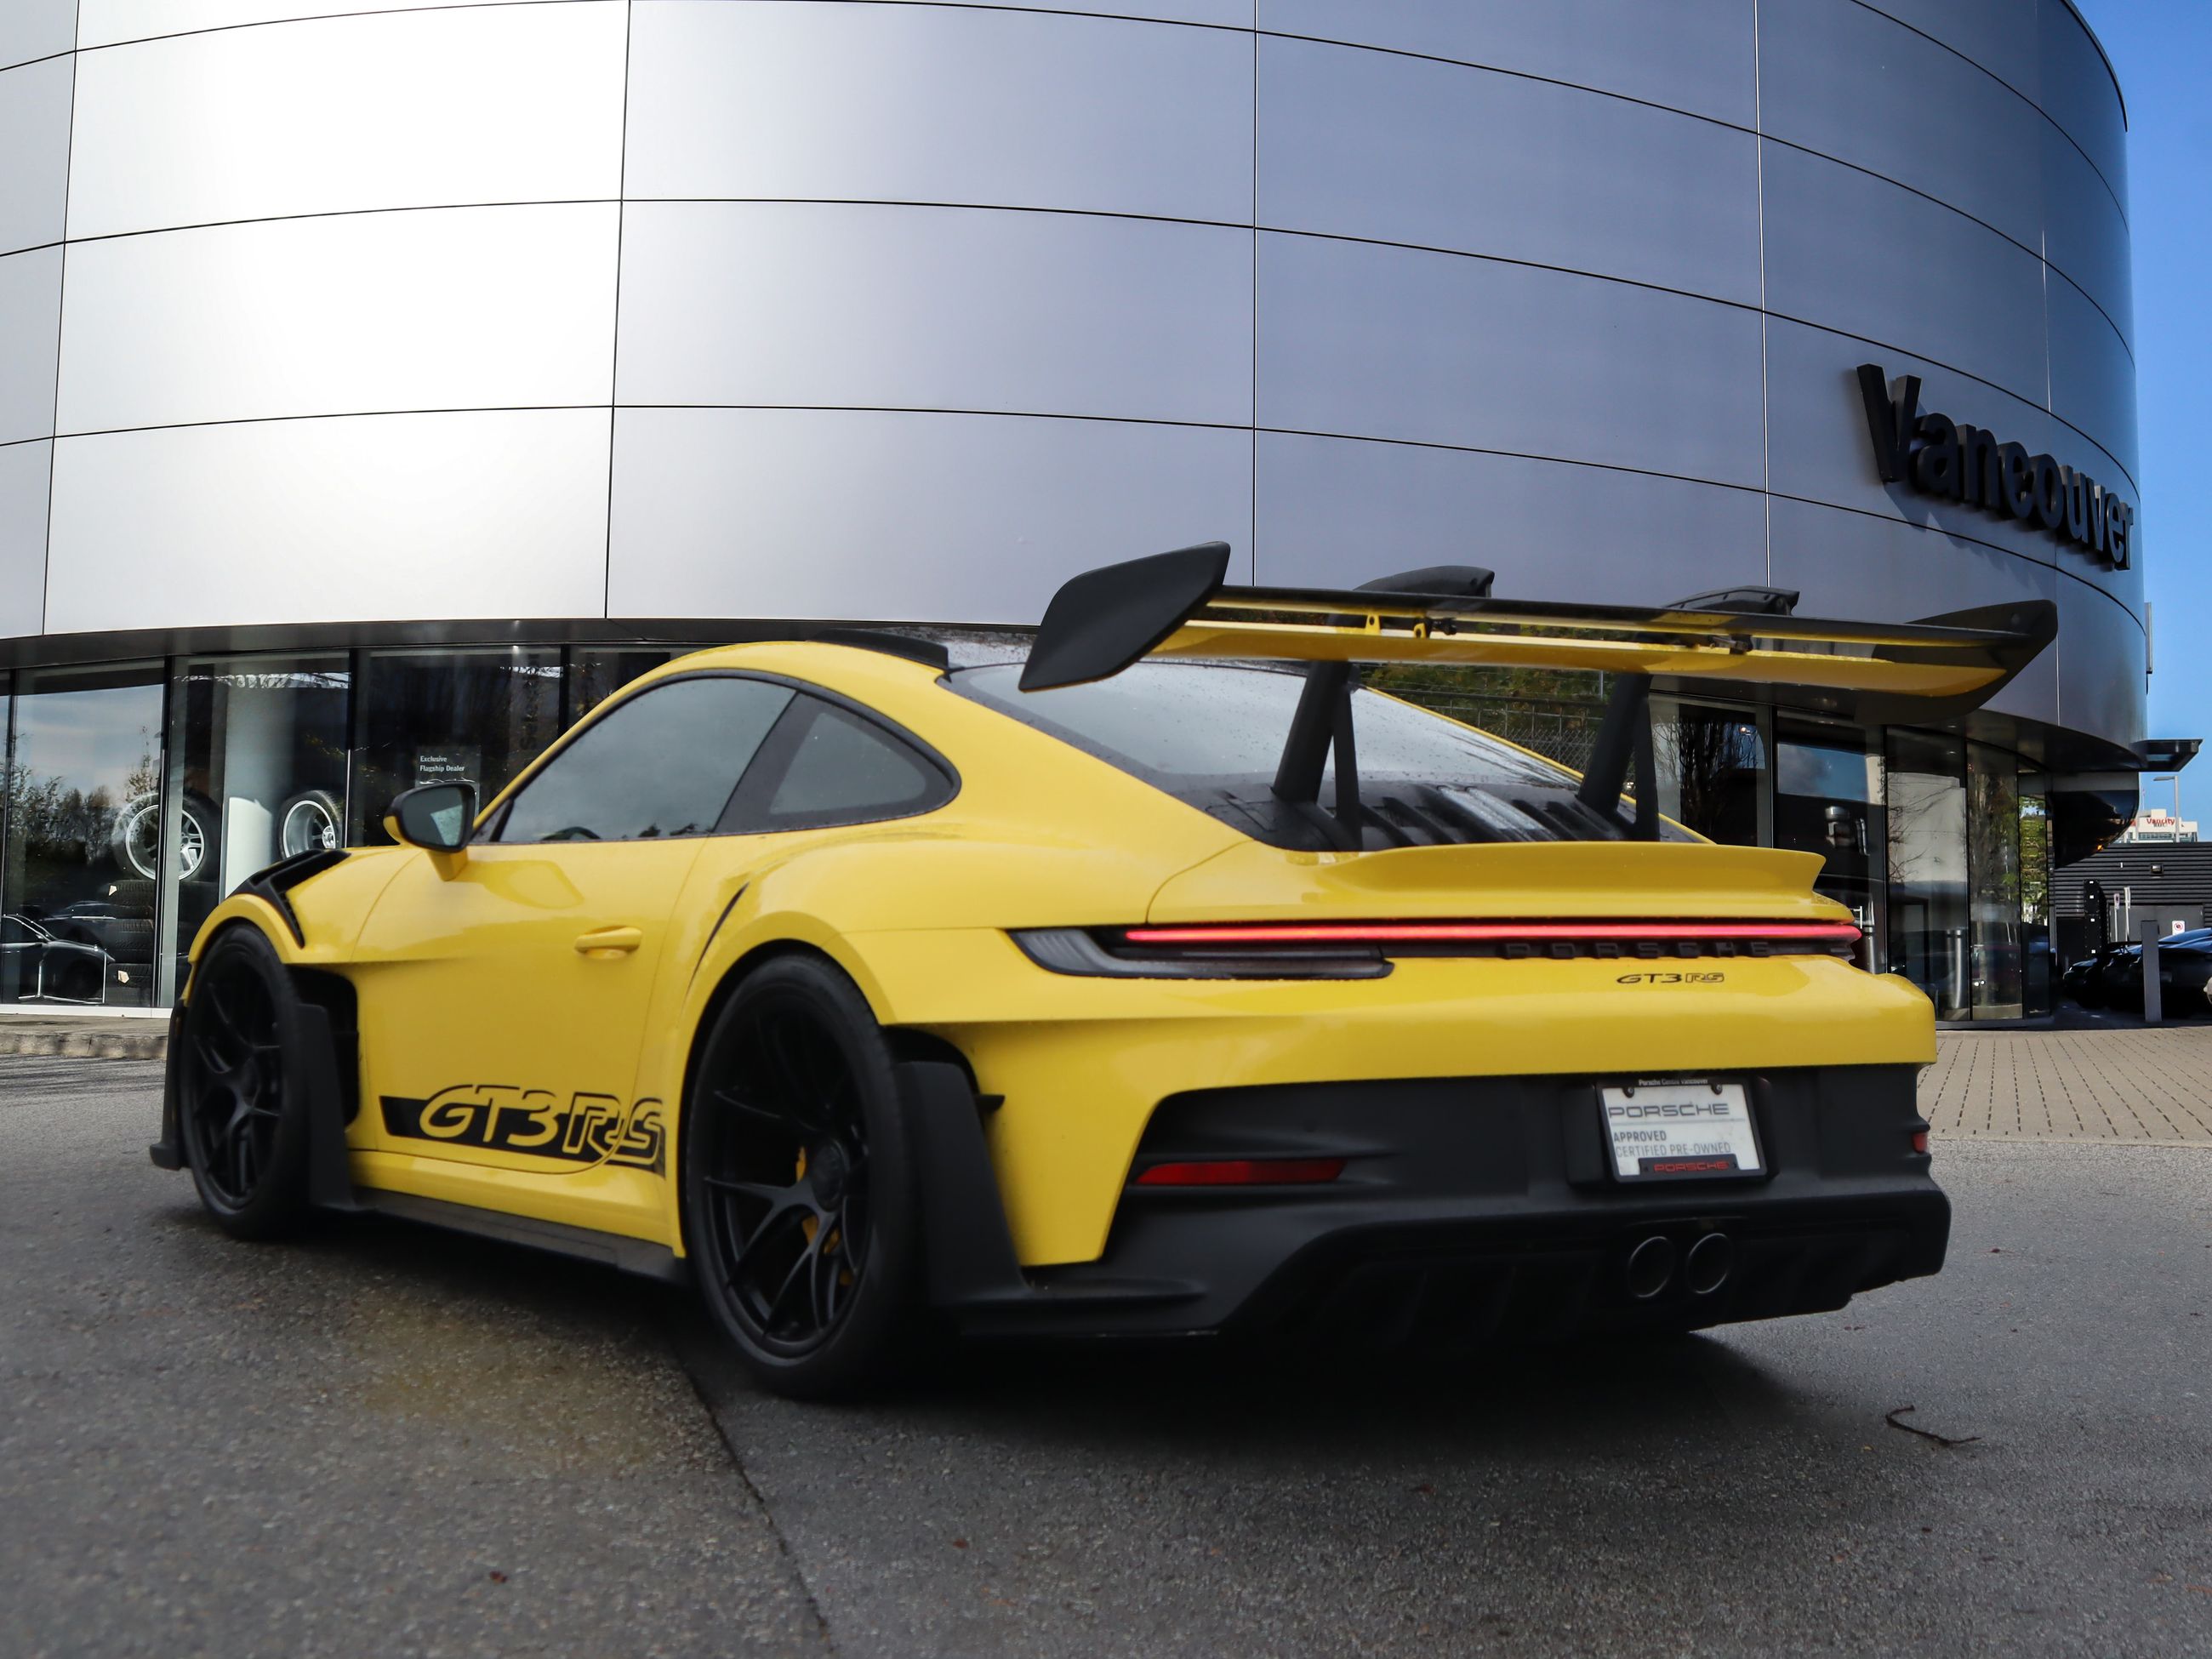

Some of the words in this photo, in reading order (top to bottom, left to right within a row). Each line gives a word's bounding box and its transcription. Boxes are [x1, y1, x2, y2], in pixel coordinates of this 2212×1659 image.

[1856, 363, 2134, 570] Vancouver
[1505, 941, 1770, 960] PORSCHE
[1608, 1103, 1730, 1118] PORSCHE
[1614, 1130, 1667, 1143] APPROVED
[1616, 1144, 1667, 1158] CERTIFIED
[1670, 1143, 1731, 1155] PRE-OWNED
[1654, 1161, 1730, 1172] PORSCHE
